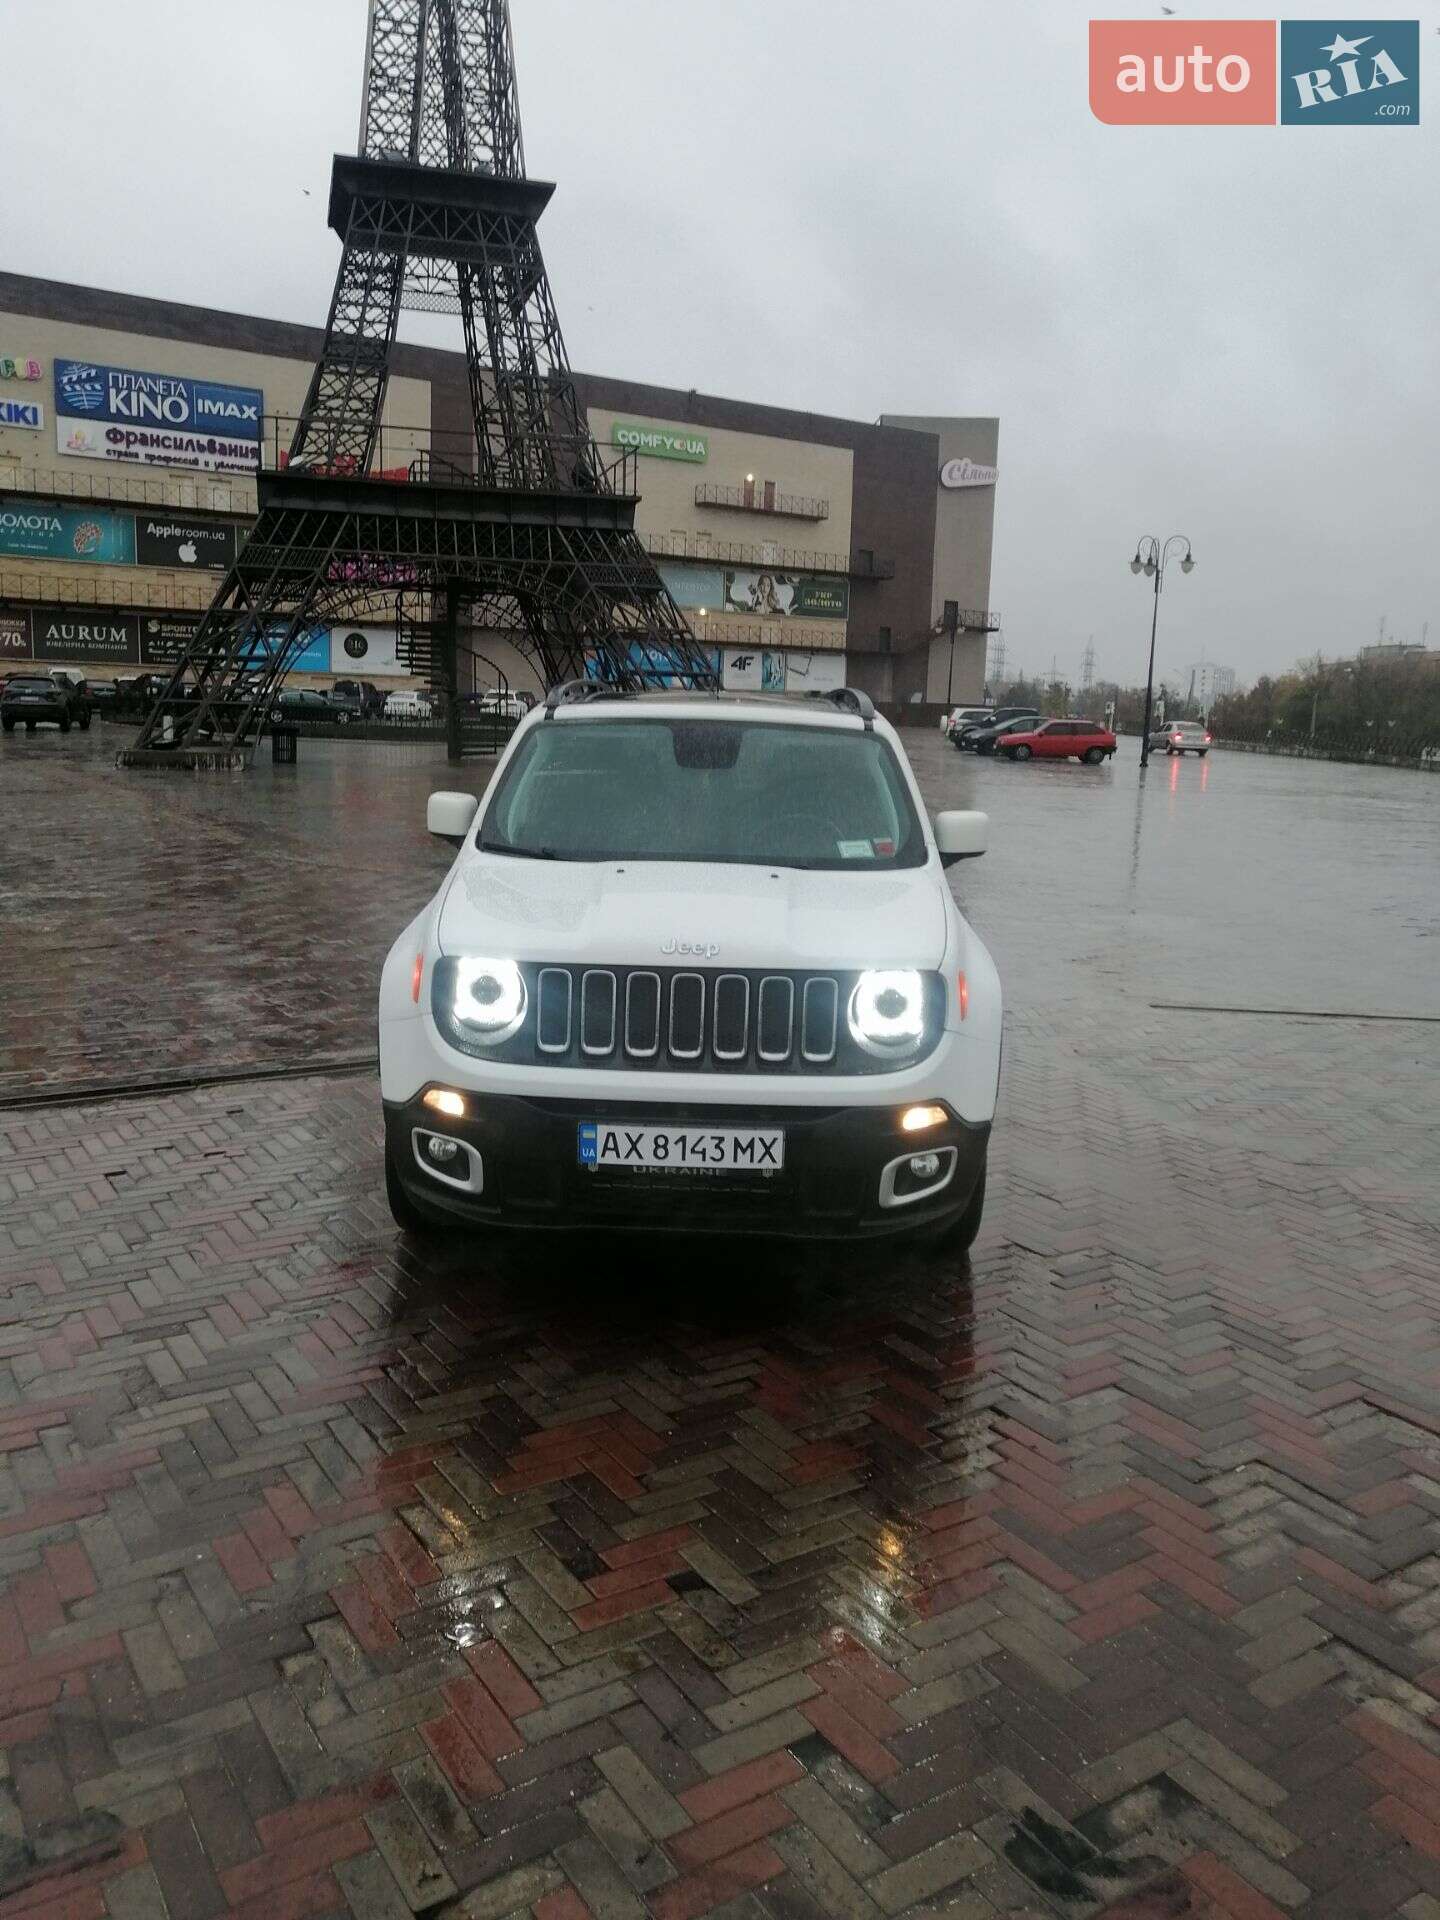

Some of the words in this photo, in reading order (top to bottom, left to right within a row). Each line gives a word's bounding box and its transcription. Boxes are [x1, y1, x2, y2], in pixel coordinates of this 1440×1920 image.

[109, 388, 190, 423] KINO
[197, 398, 258, 421] IMAX
[617, 429, 674, 450] COMFY
[146, 522, 226, 541] Appleroom.ua
[45, 624, 128, 642] AURUM
[661, 936, 720, 960] Jeep
[582, 1148, 597, 1158] UA
[600, 1131, 645, 1160] AX
[652, 1134, 726, 1163] 8143
[733, 1136, 779, 1164] MX
